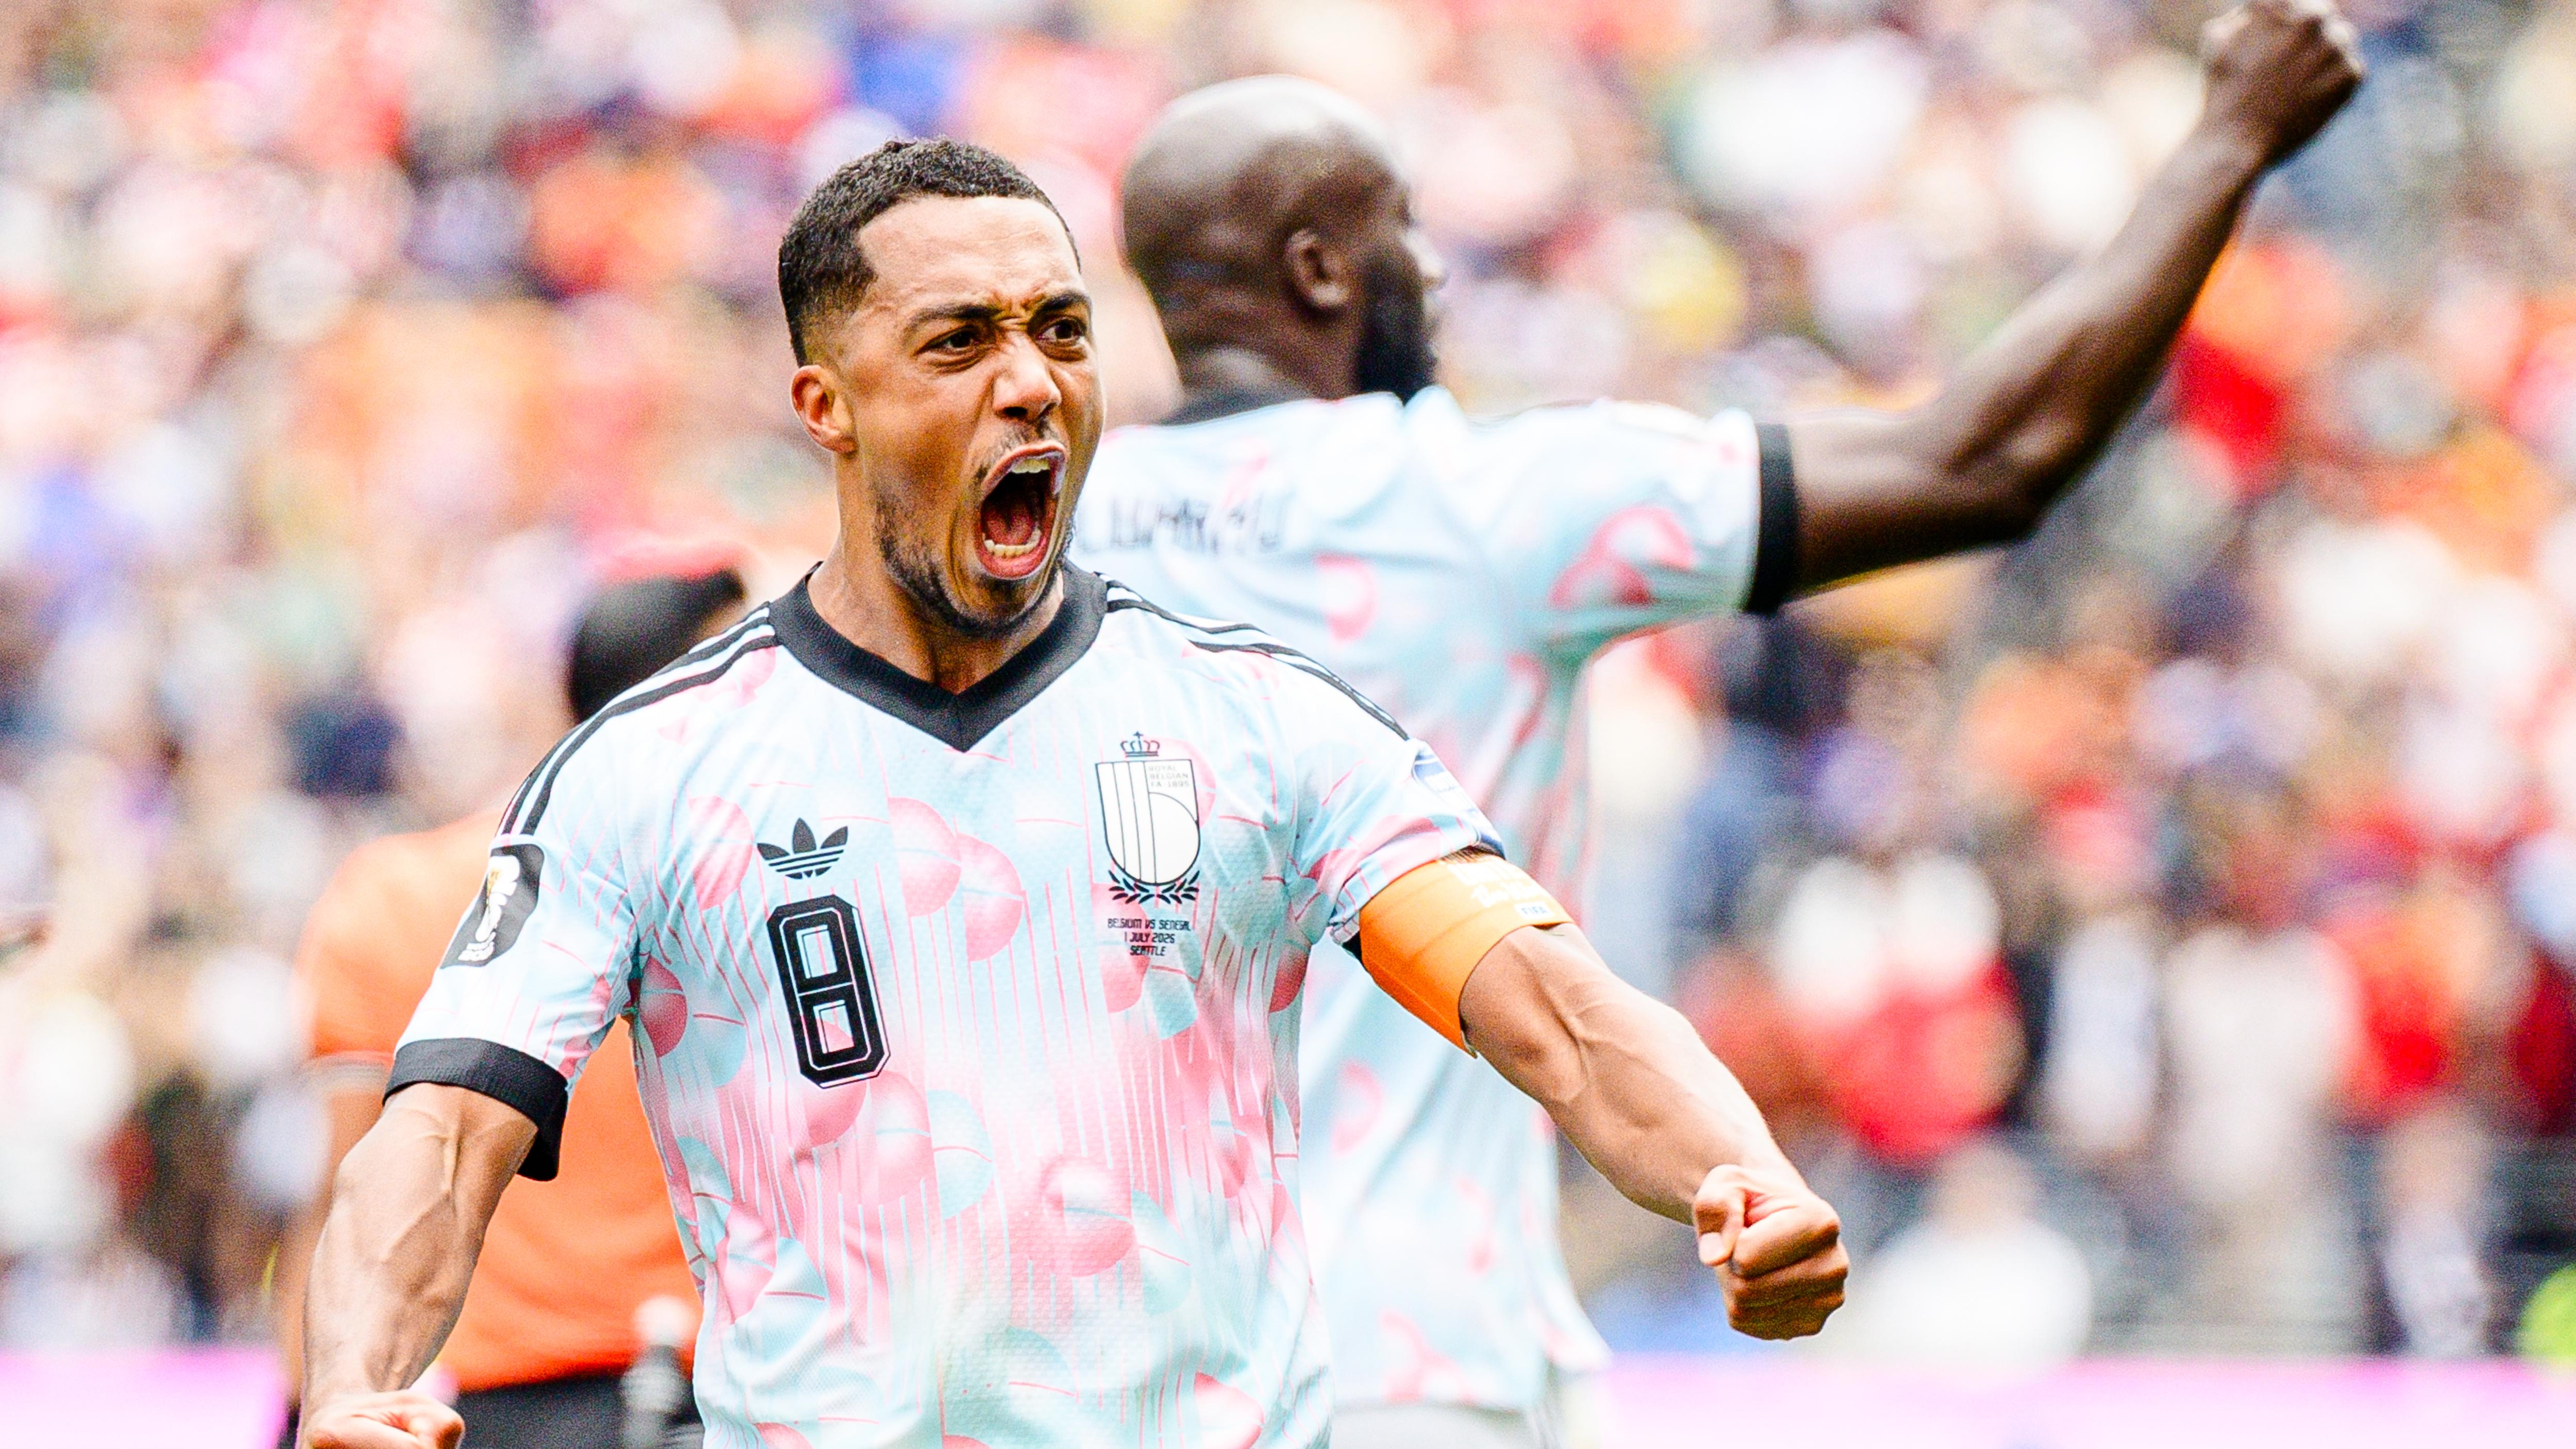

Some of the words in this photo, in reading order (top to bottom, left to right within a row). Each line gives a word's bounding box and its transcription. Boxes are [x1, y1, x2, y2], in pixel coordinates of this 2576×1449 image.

[1521, 906, 1547, 915] FIFA
[1108, 918, 1142, 929] BELGIUM
[1145, 919, 1156, 929] VS
[1159, 919, 1191, 931] SENEGAL
[1130, 932, 1150, 943] JULY
[1130, 945, 1166, 957] SEATTLE
[767, 894, 891, 1089] 8
